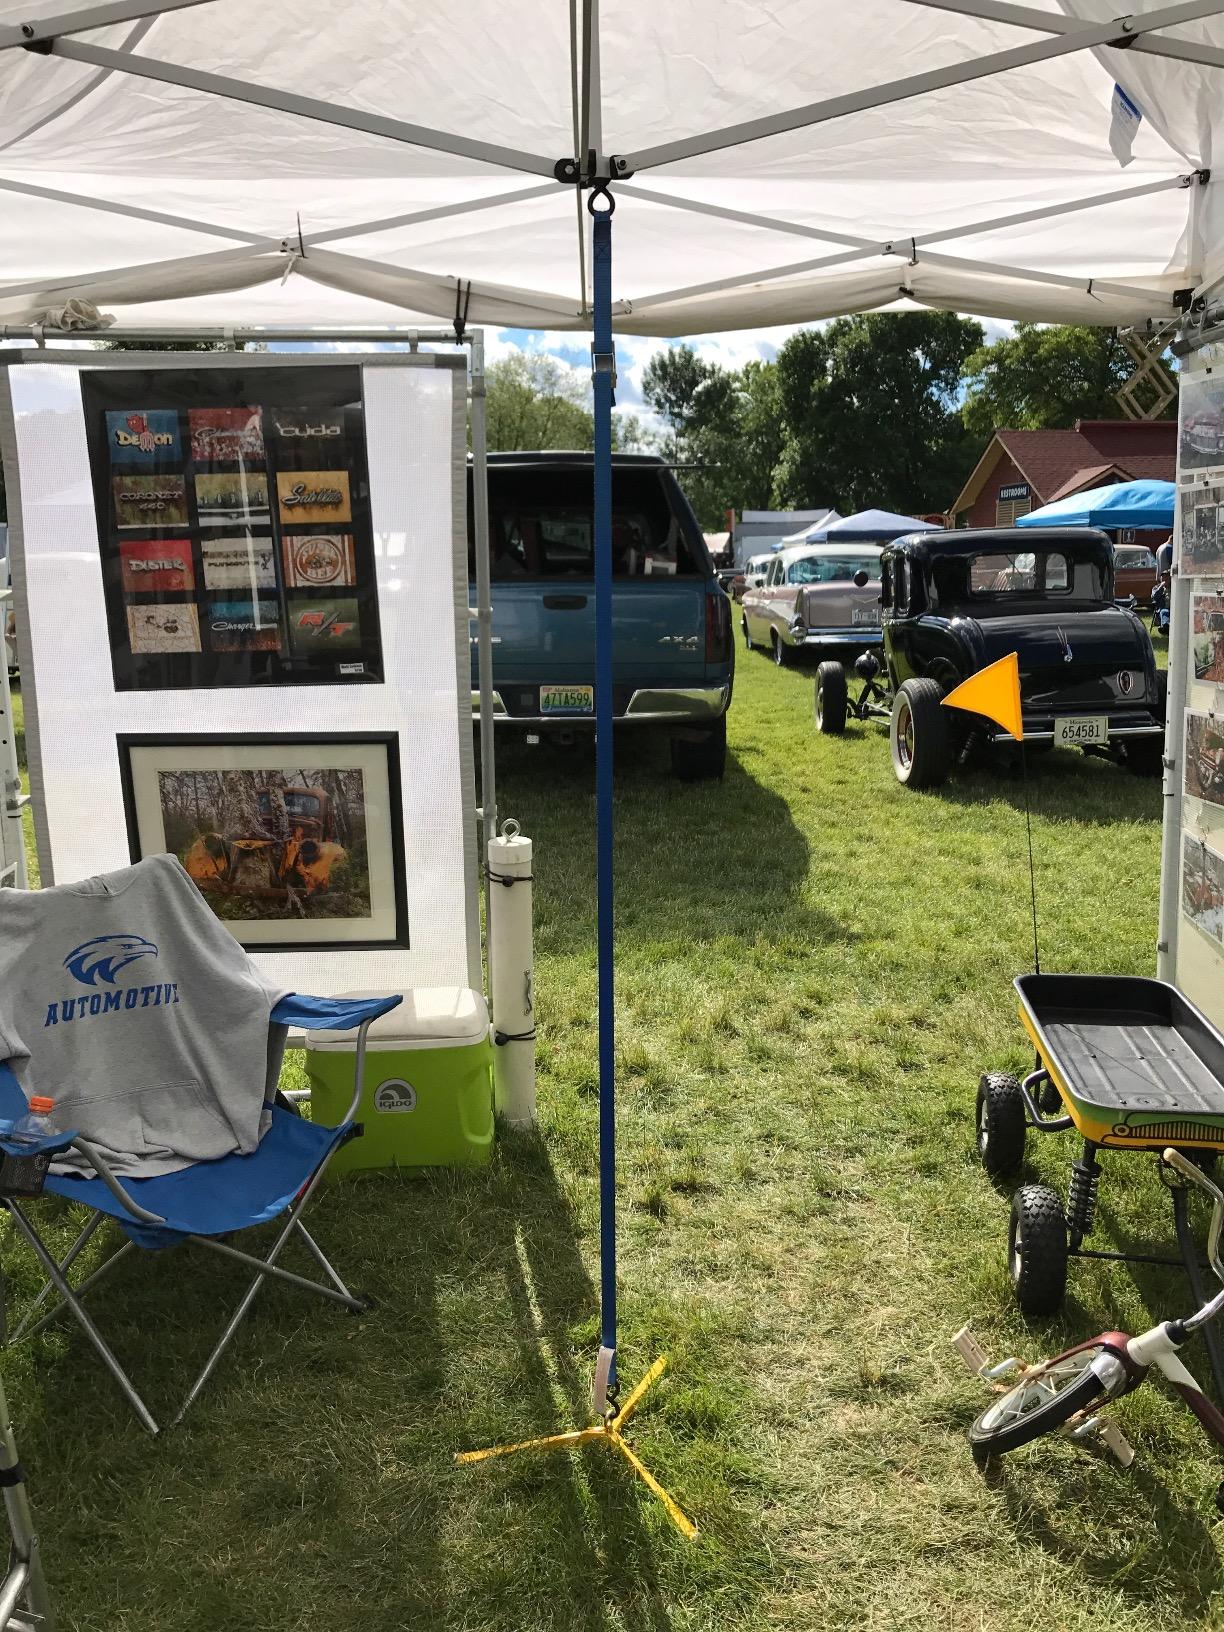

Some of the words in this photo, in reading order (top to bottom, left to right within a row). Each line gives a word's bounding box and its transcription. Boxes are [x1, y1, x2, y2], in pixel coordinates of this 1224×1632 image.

[298, 611, 353, 636] R/T
[544, 692, 590, 706] 47TA599
[1061, 725, 1100, 739] 654581
